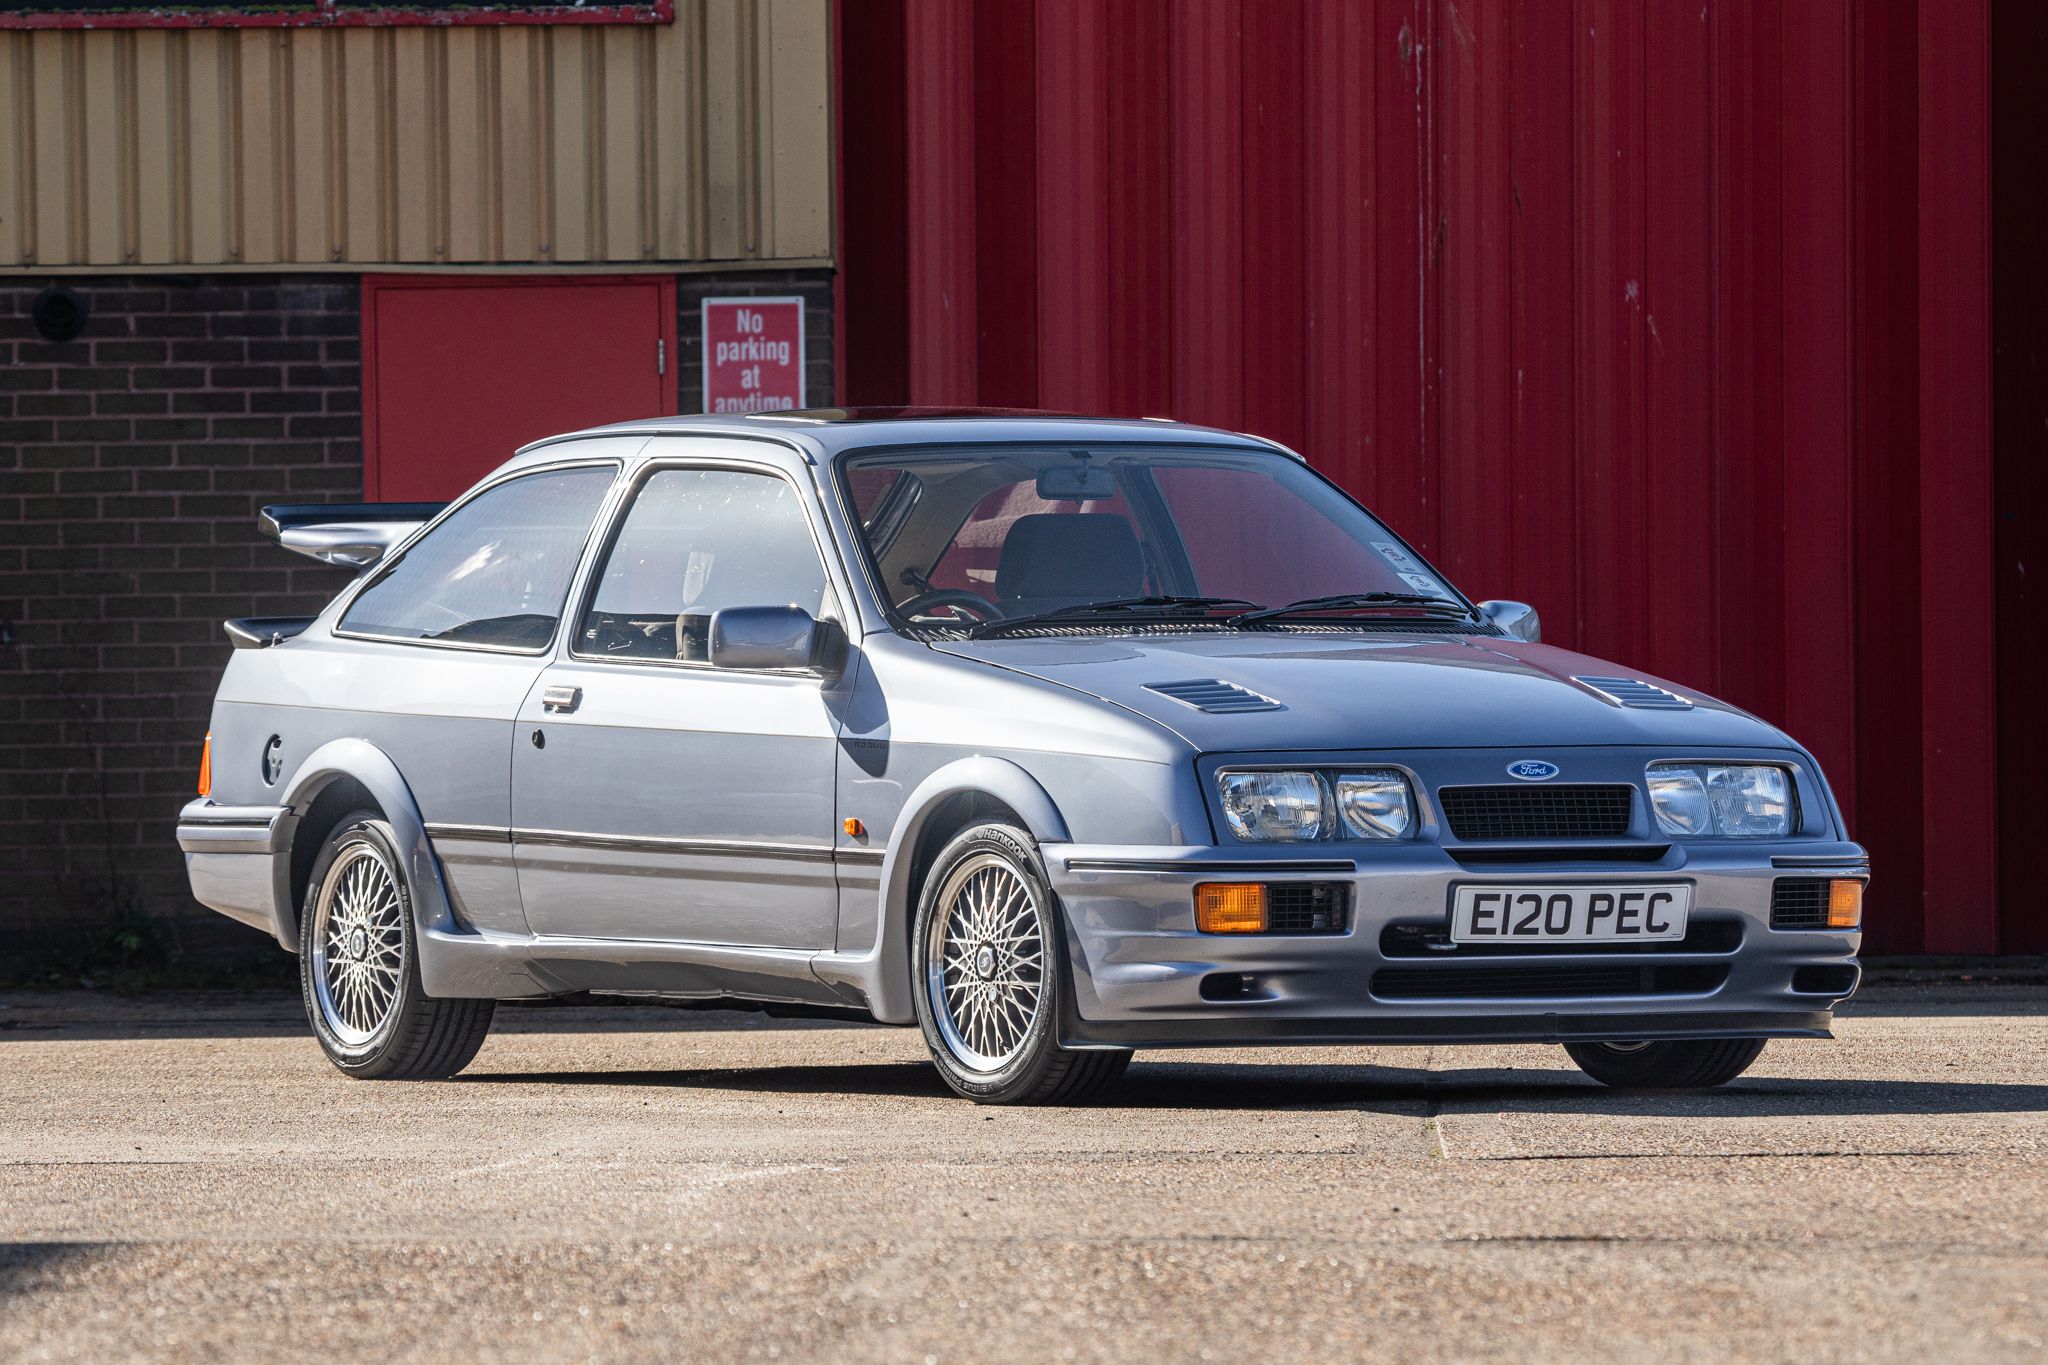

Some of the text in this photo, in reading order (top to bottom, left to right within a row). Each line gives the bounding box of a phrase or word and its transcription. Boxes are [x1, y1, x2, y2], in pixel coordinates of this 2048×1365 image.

[736, 308, 763, 333] No
[716, 336, 789, 367] parking
[741, 364, 761, 389] at
[715, 392, 793, 413] anytime
[1520, 763, 1548, 775] Ford
[1470, 892, 1673, 935] E120 PEC
